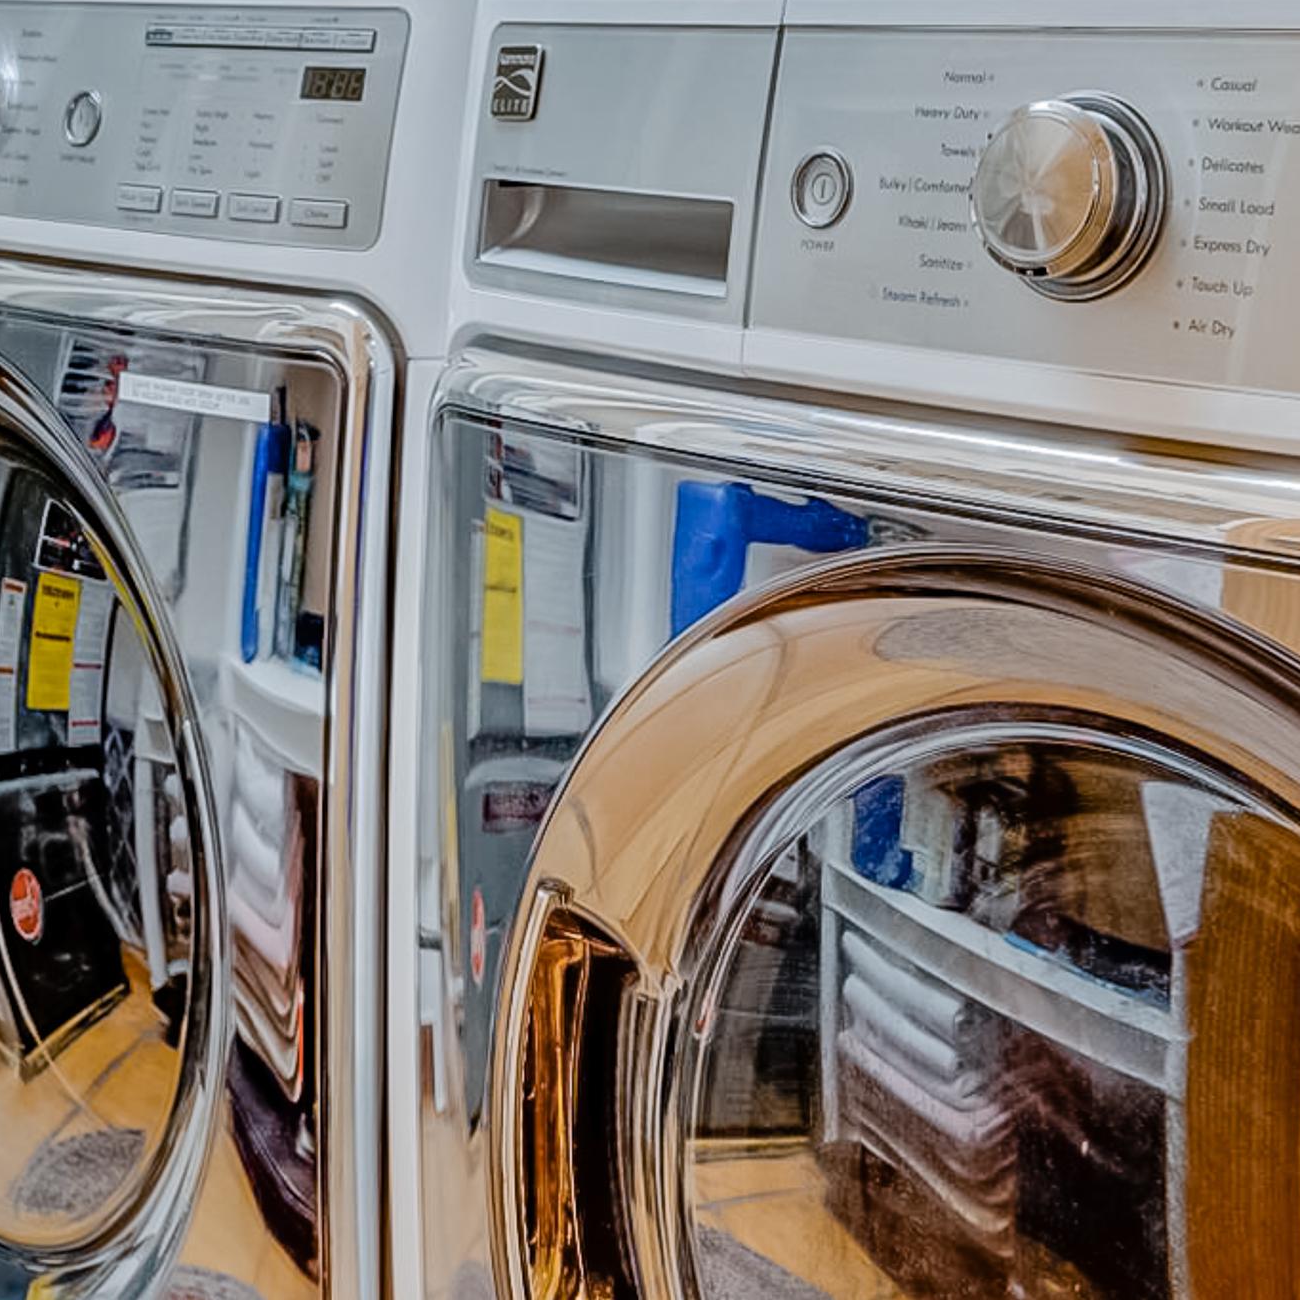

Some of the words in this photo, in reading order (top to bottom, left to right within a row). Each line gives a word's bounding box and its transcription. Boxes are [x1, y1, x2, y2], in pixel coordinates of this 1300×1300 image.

[943, 70, 987, 84] Normal
[1211, 76, 1257, 92] Casual
[953, 106, 980, 120] Duty
[1208, 118, 1263, 133] Workout
[1202, 156, 1264, 174] Delicates
[1199, 197, 1235, 214] Small
[1240, 199, 1275, 216] Load
[1194, 236, 1242, 255] Express
[1247, 240, 1270, 257] Dry
[1192, 276, 1228, 293] Touch
[1233, 283, 1253, 298] Up
[1188, 319, 1206, 333] Air
[1212, 321, 1235, 338] Dry
